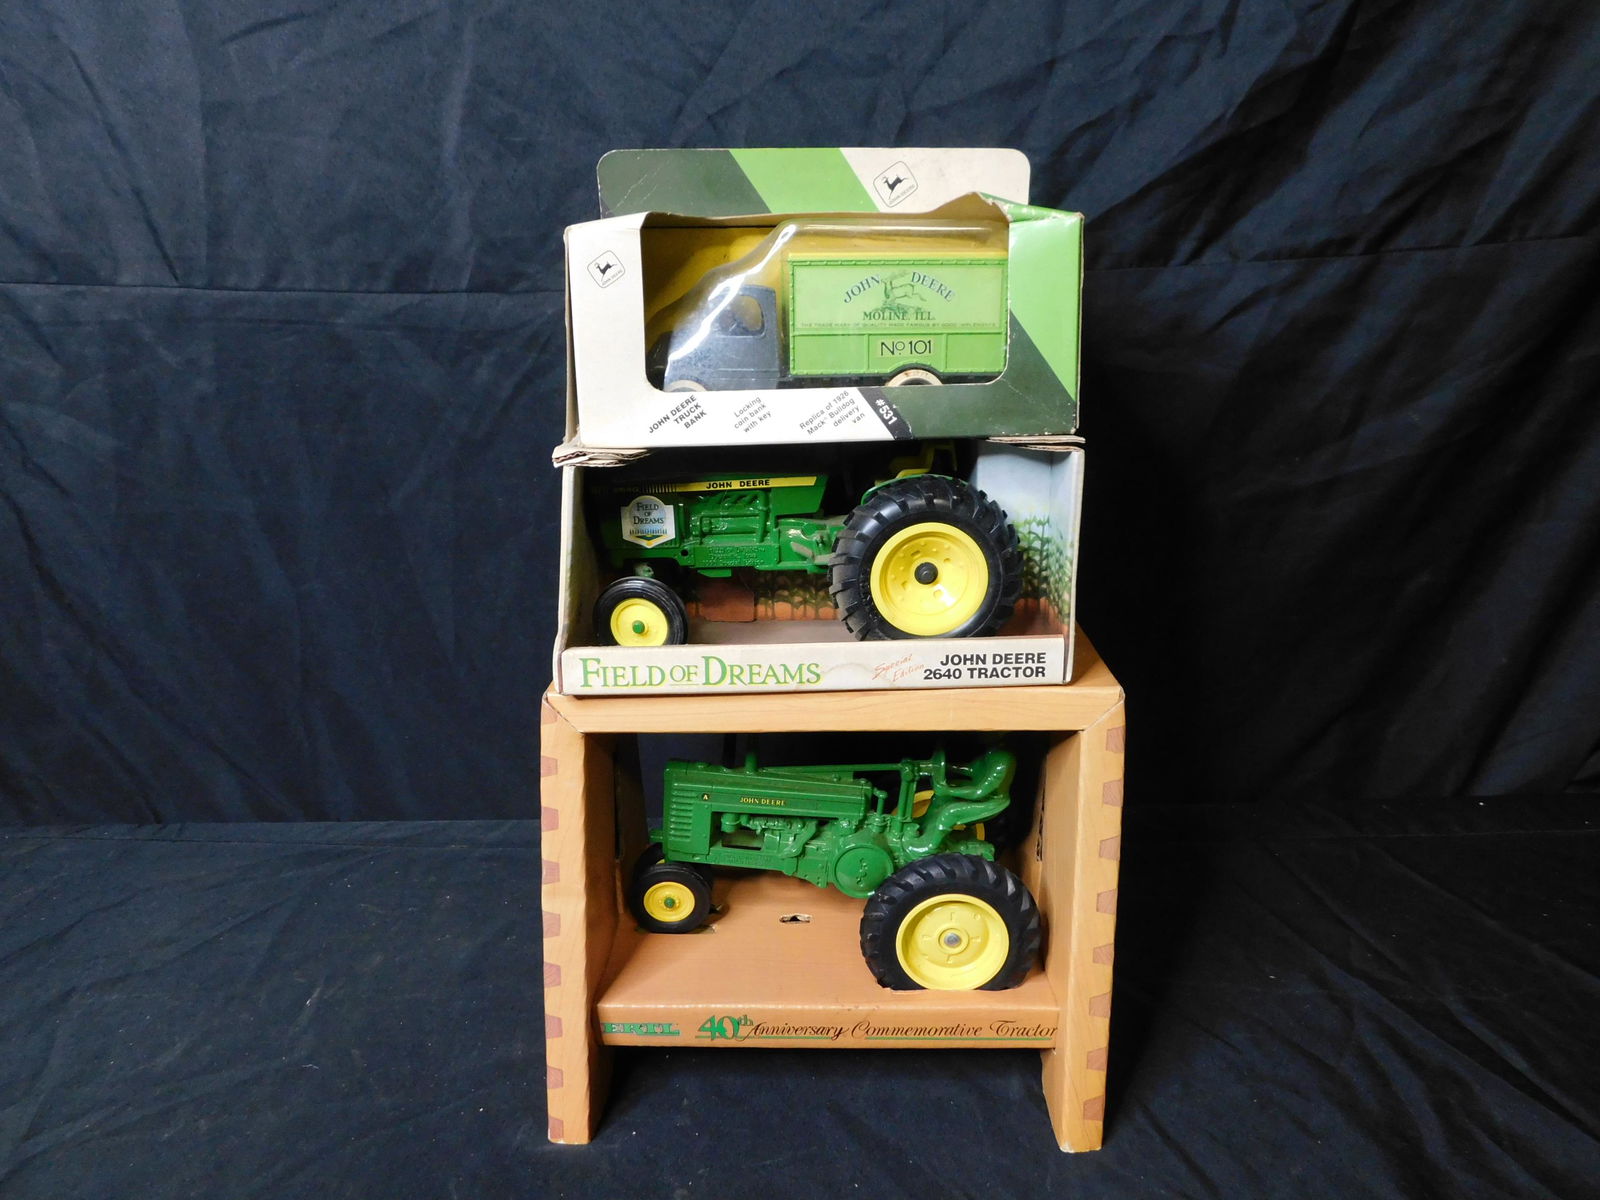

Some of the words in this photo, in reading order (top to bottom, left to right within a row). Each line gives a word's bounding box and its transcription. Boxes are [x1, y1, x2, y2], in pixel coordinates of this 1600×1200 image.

[844, 274, 881, 304] JOHN
[911, 271, 955, 302] DEERE
[909, 340, 932, 355] 101
[649, 414, 671, 434] JOHN
[670, 395, 697, 417] DEERE
[673, 402, 702, 425] TRUCK
[734, 396, 762, 418] Locking
[734, 416, 750, 429] coin
[750, 403, 767, 418] bank
[799, 409, 825, 430] Replica
[825, 402, 834, 411] of
[828, 397, 855, 419] Bulldog
[833, 405, 860, 427] delivery
[875, 398, 898, 425] #531
[684, 409, 708, 429] BANK
[744, 421, 759, 433] with
[759, 410, 772, 422] key
[852, 412, 866, 424] van
[706, 481, 732, 489] JOHN
[739, 479, 770, 487] DEERE
[636, 503, 659, 512] FIELD
[633, 516, 664, 525] DREAMS
[940, 654, 987, 666] JOHN
[992, 652, 1046, 665] DEERE
[579, 657, 666, 688] FIELD
[669, 664, 698, 682] OF
[701, 655, 821, 686] DREAMS
[923, 668, 962, 680] 2640
[967, 666, 1046, 679] TRACTOR
[702, 793, 709, 801] A
[761, 798, 785, 806] DEERE
[600, 1022, 680, 1036] ERTL
[736, 1021, 849, 1041] Anniversary
[851, 1020, 983, 1037] Commemorative
[990, 1020, 1058, 1037] Tractor
